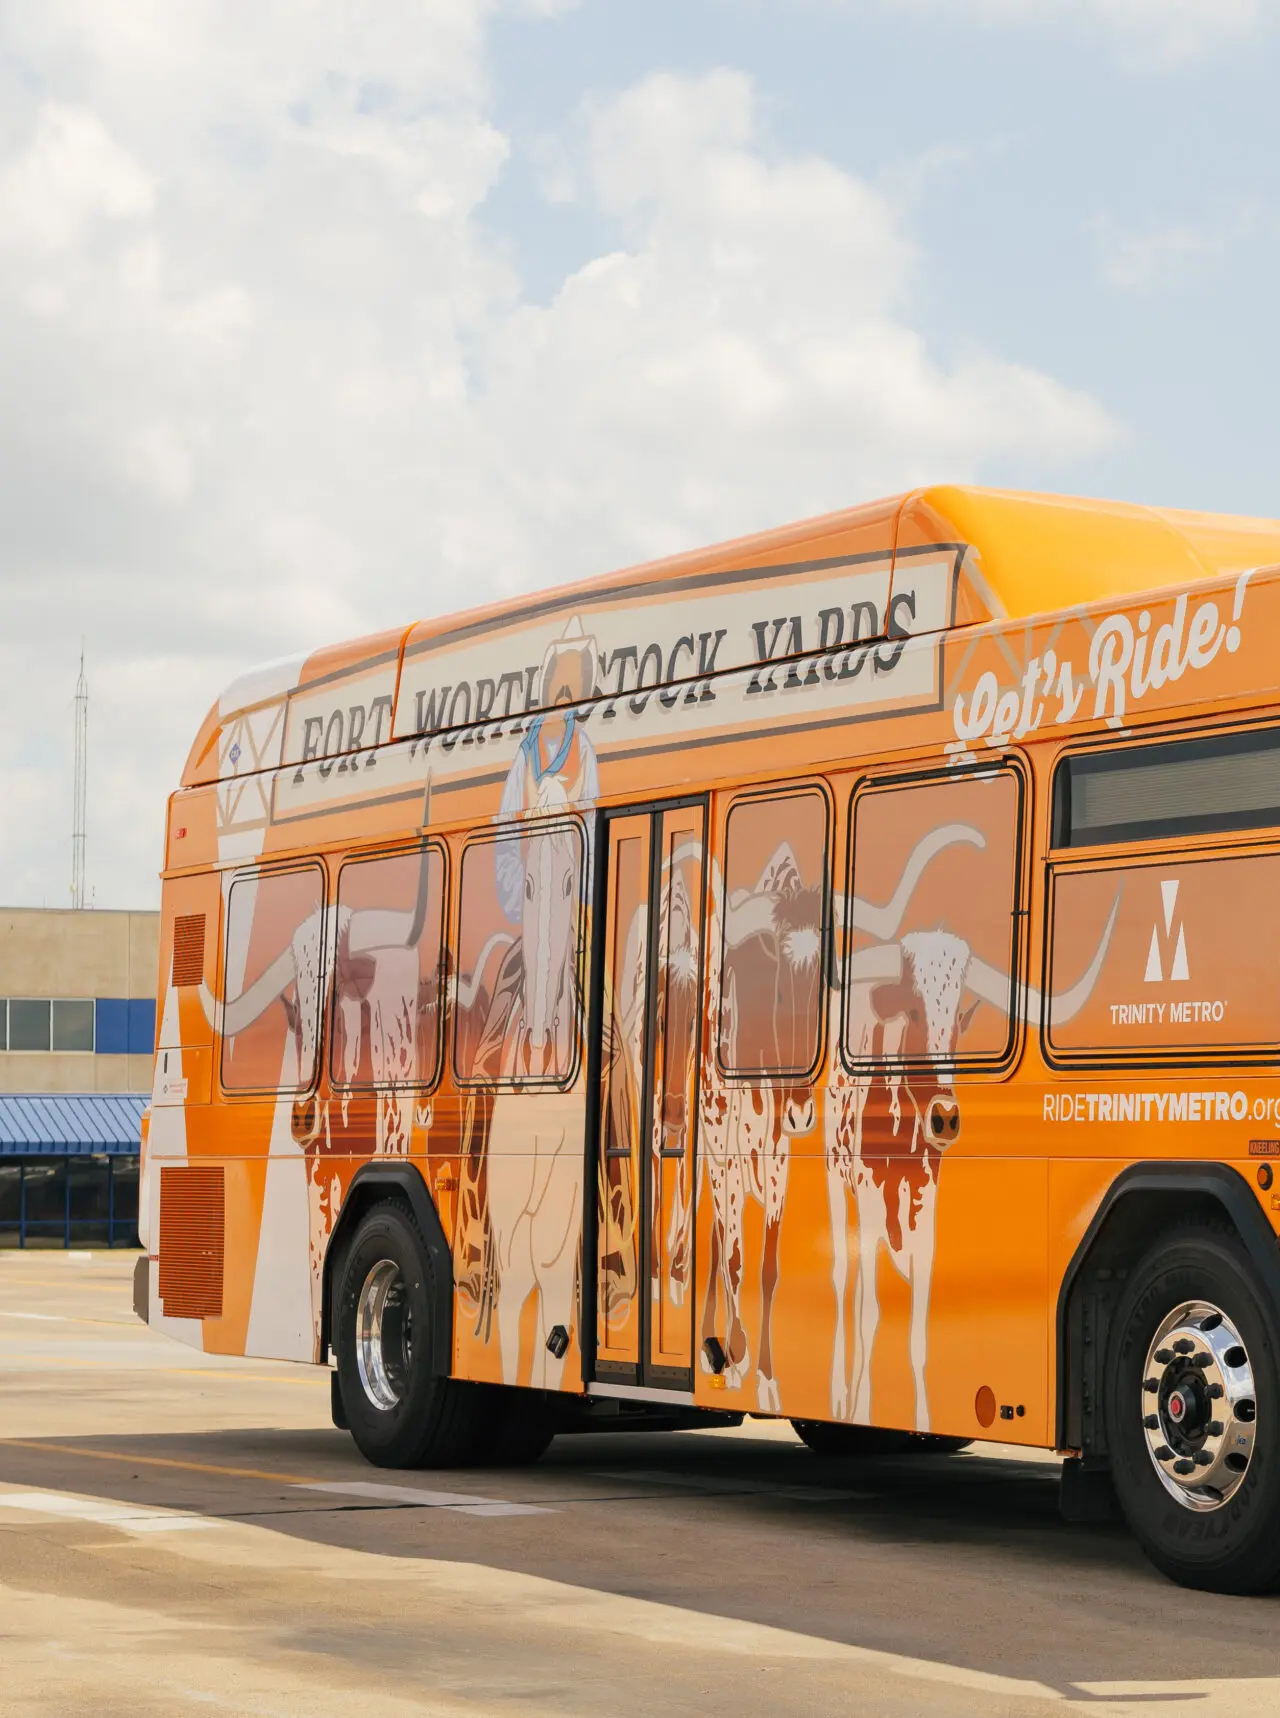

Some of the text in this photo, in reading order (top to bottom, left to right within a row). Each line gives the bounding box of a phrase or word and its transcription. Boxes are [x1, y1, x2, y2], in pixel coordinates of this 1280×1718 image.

[293, 694, 393, 784] FORT
[746, 590, 917, 694] YARDS
[1089, 567, 1260, 736] Ride!
[1110, 1001, 1224, 1025] TRINITY METRO
[1250, 1141, 1280, 1155] KNEELING
